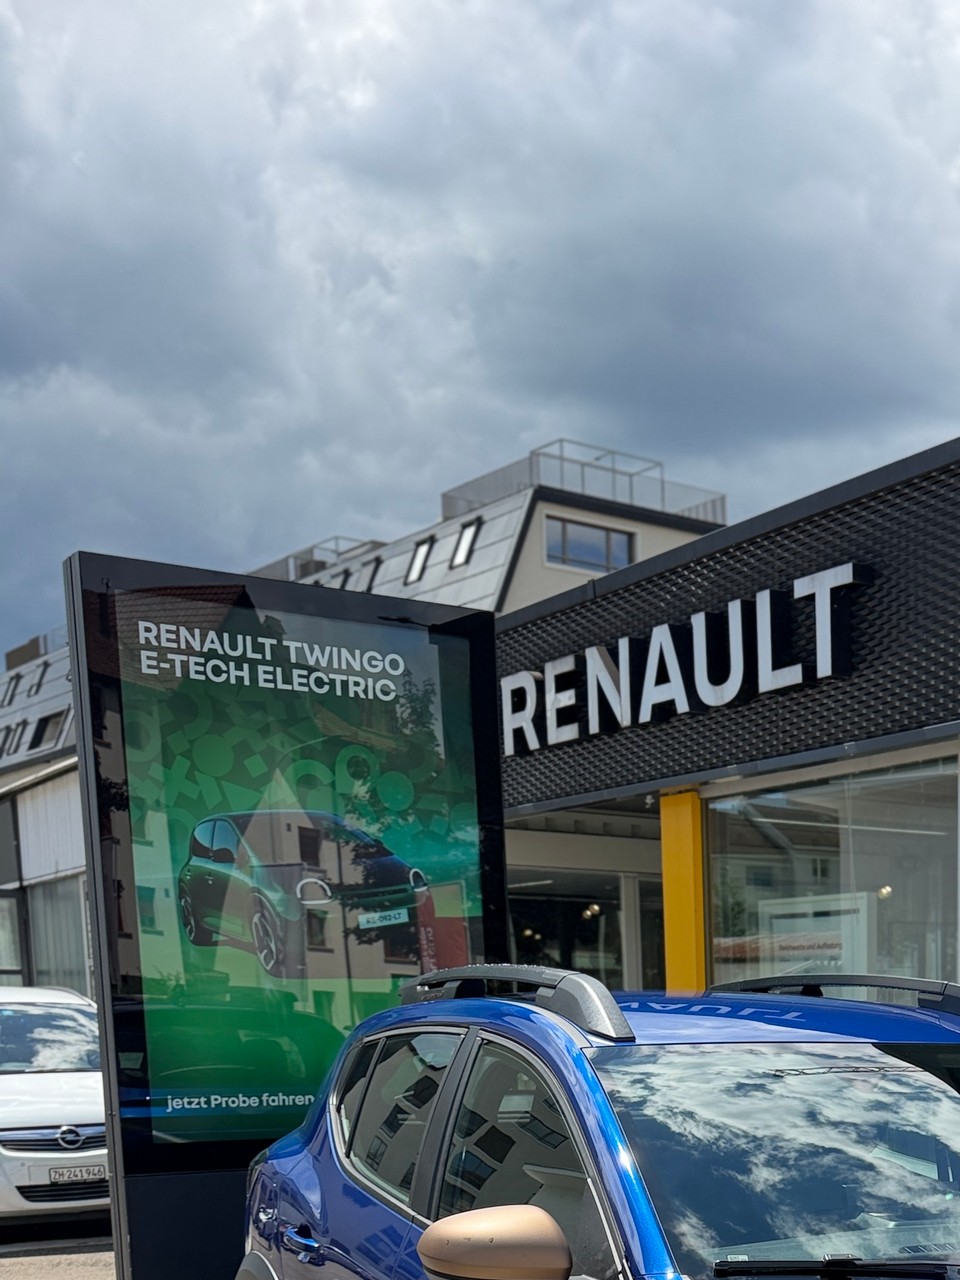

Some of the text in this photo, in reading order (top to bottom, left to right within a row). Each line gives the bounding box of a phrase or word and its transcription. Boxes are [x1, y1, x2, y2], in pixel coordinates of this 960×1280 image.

[138, 620, 405, 676] RENAULT TWINGO
[500, 562, 853, 757] RENAULT
[140, 650, 397, 701] E-TECH ELECTRIC
[166, 1092, 315, 1113] jetzt Probe fahren
